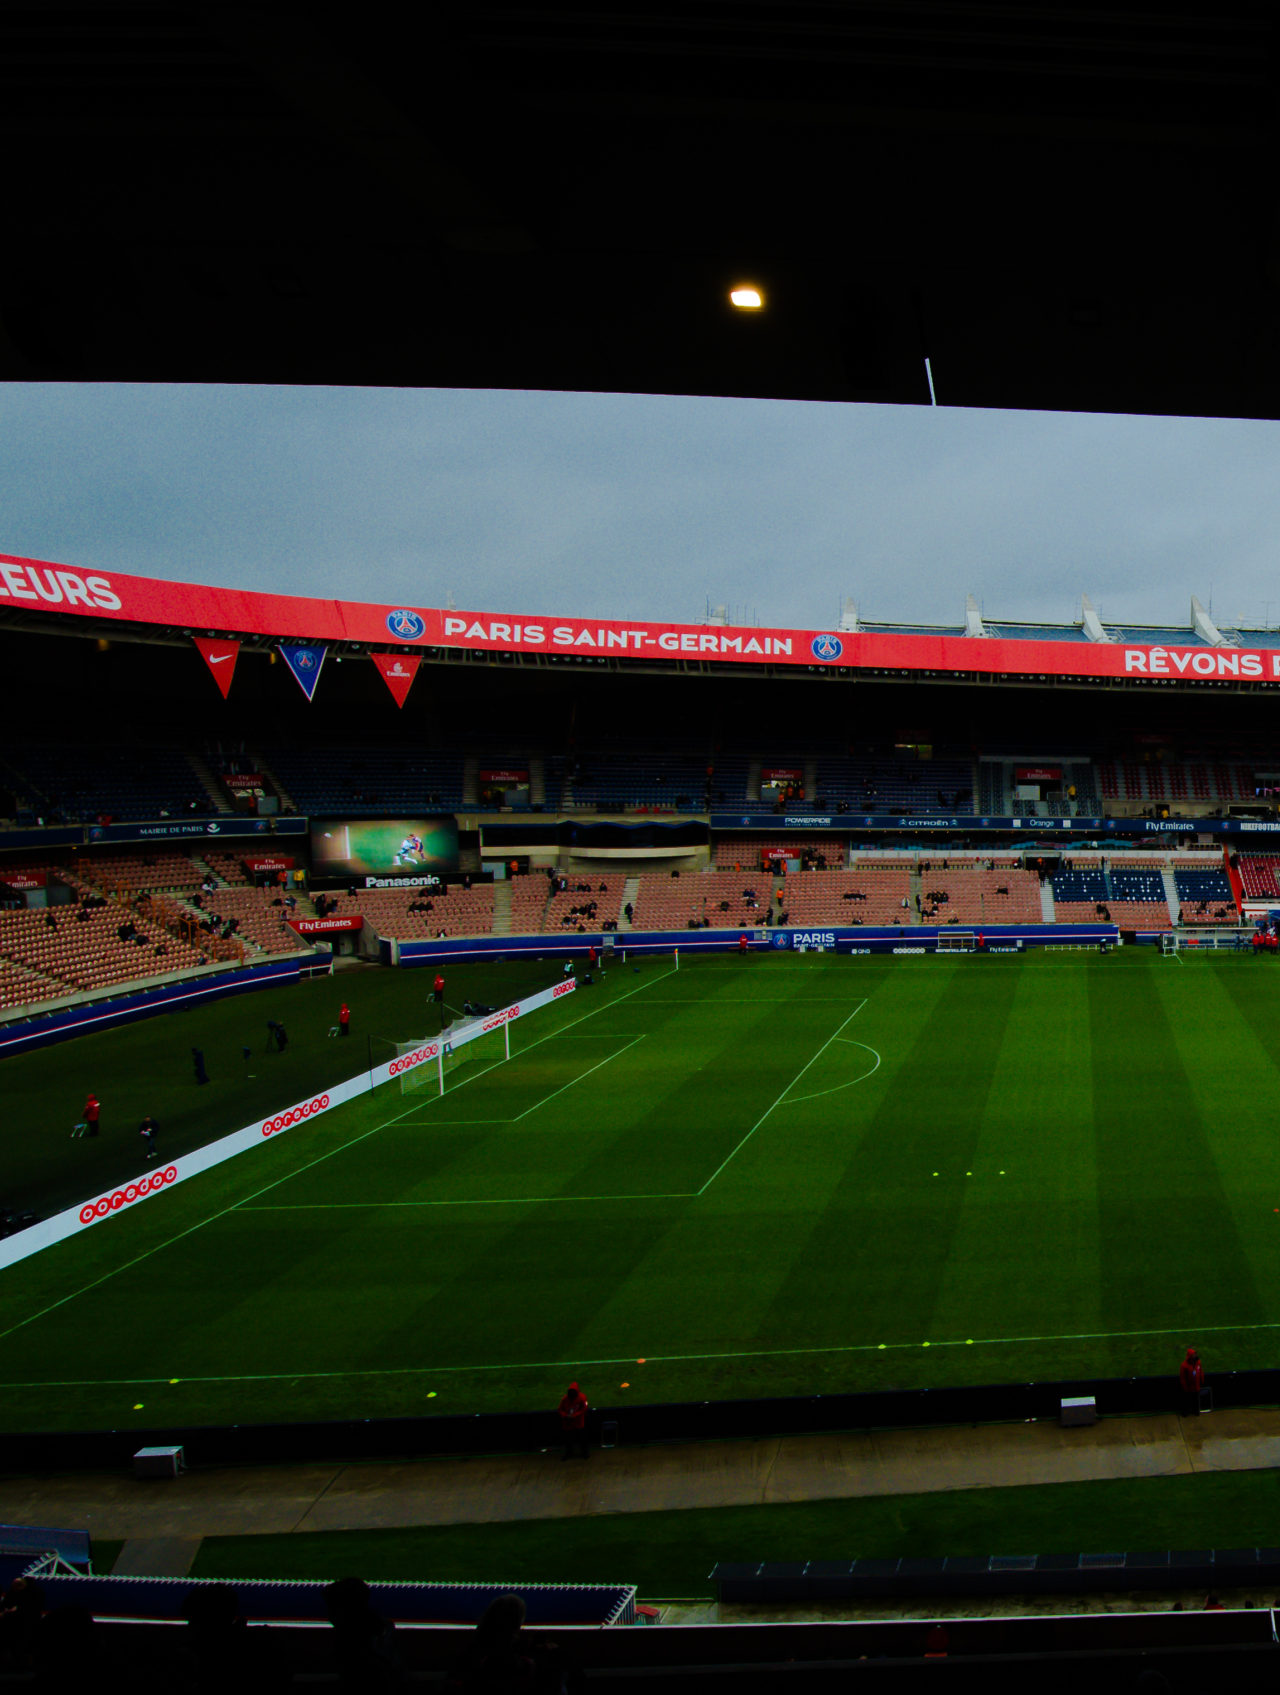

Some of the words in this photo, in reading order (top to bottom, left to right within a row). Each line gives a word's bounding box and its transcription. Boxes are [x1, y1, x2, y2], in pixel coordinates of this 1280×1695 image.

[445, 617, 546, 643] PARIS
[553, 627, 793, 655] SAINT-GERMAIN
[1125, 647, 1263, 676] RÊVONS
[139, 826, 168, 835] MAIRIE
[169, 826, 181, 834] DE
[181, 825, 204, 833] PARIS
[1030, 819, 1055, 828] Orange
[1159, 822, 1195, 831] Emirates
[365, 874, 440, 888] Panasonic
[299, 921, 314, 932] Fly
[314, 919, 352, 929] Emirates
[793, 933, 835, 943] PARIS
[389, 1043, 439, 1075] ooredoo
[262, 1095, 330, 1136] ooredoo
[79, 1166, 177, 1224] ooredoo
